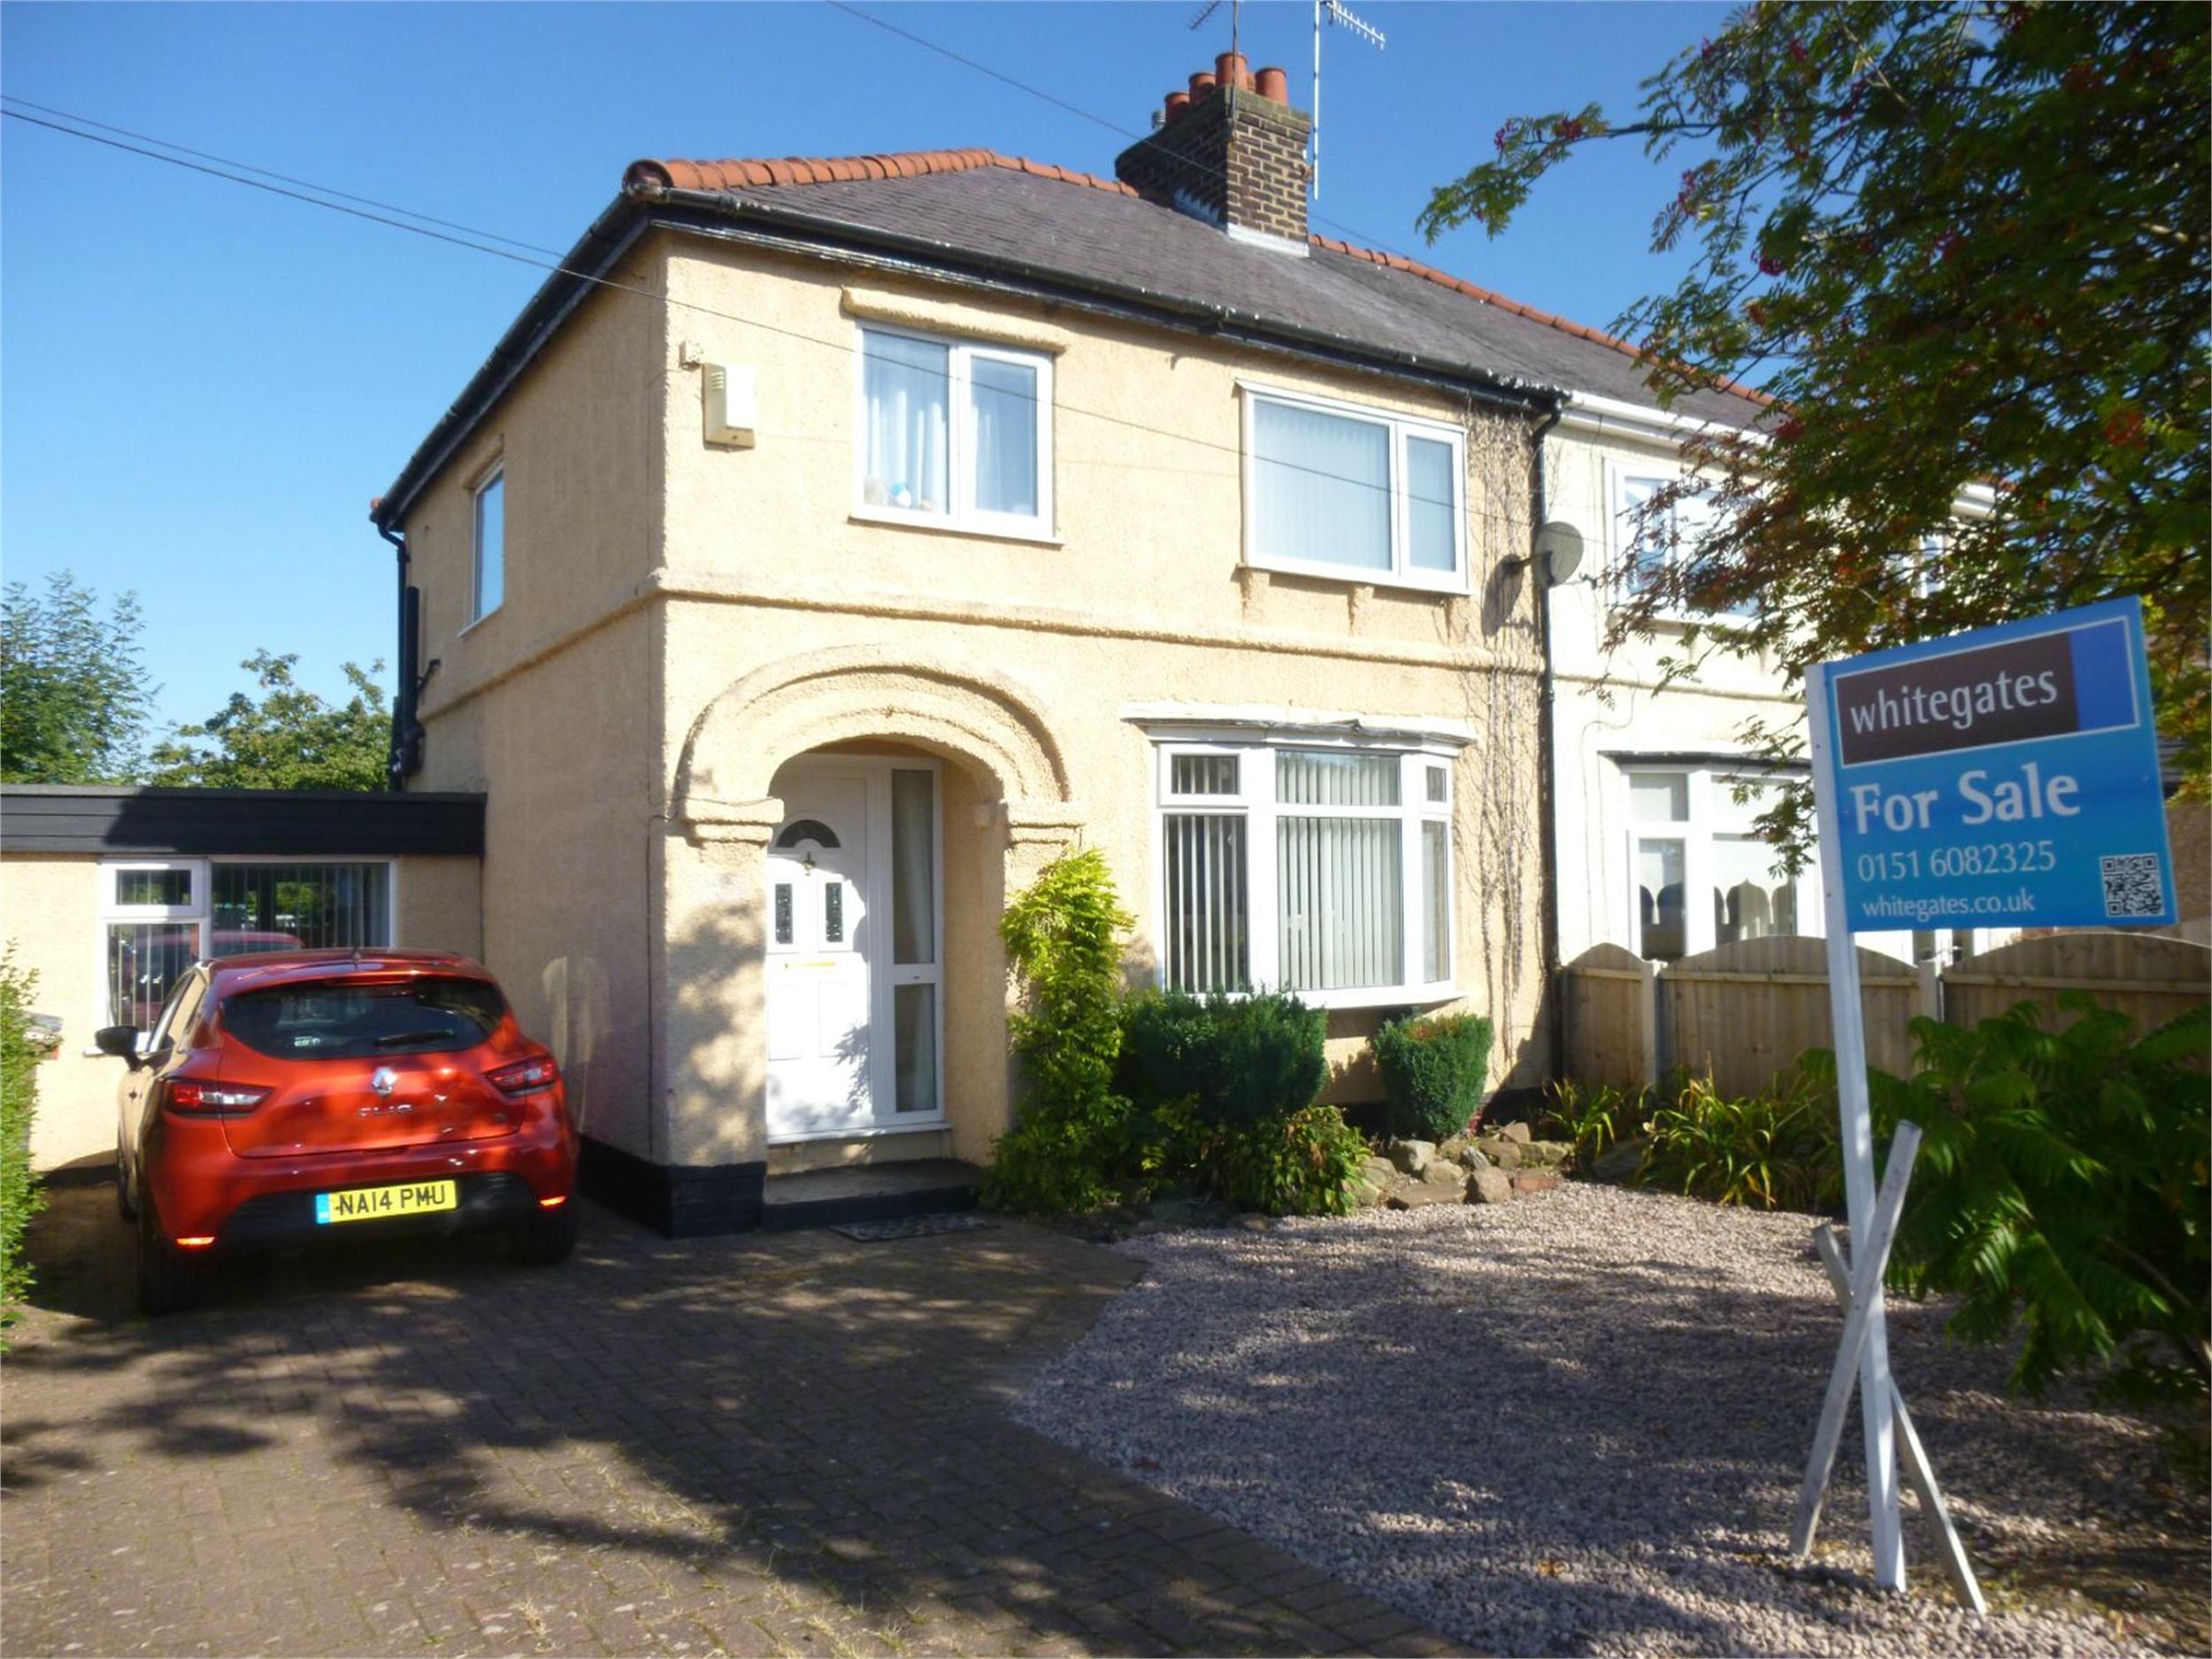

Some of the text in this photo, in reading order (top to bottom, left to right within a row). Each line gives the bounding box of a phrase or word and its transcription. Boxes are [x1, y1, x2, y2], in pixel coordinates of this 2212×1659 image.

[1849, 669, 2057, 734] whitegates
[1848, 761, 2081, 834] For Sale
[1858, 841, 2055, 882] 0151 6082325
[1863, 887, 2035, 923] whitegates.co.uk
[339, 1185, 446, 1216] NA14 PMU
